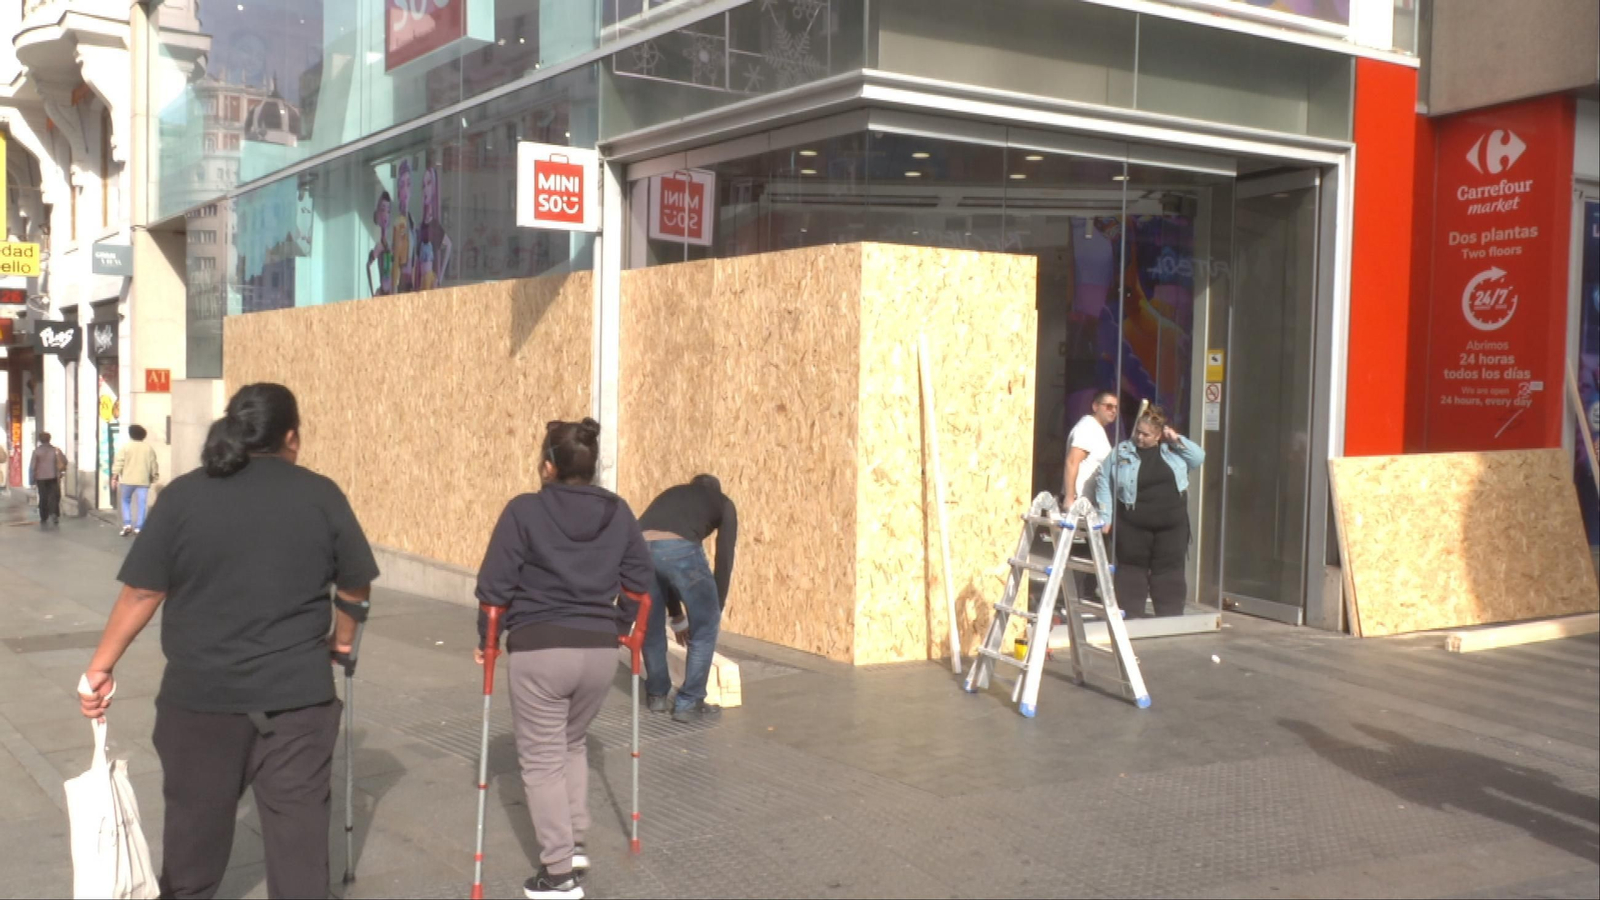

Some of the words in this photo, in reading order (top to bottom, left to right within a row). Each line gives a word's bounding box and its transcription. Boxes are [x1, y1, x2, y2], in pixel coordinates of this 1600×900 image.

[538, 172, 579, 193] MINI
[1456, 179, 1533, 201] Carrefour
[1467, 196, 1520, 215] market
[1448, 231, 1478, 246] Dos
[1481, 226, 1539, 246] plantas
[0, 245, 33, 257] dad
[1461, 247, 1487, 259] Two
[1488, 246, 1522, 257] floors
[0, 260, 31, 273] ello
[1474, 288, 1509, 305] 24/7
[1466, 340, 1509, 351] Abrimos
[1459, 352, 1476, 365] 24
[1479, 353, 1515, 364] horas
[148, 371, 168, 383] AT
[1443, 368, 1479, 379] todos
[1481, 368, 1500, 379] los
[1503, 366, 1531, 379] días
[1461, 387, 1475, 395] We
[1489, 388, 1510, 396] open
[1440, 395, 1453, 405] 24
[1485, 397, 1512, 407] every
[1513, 396, 1533, 408] day
